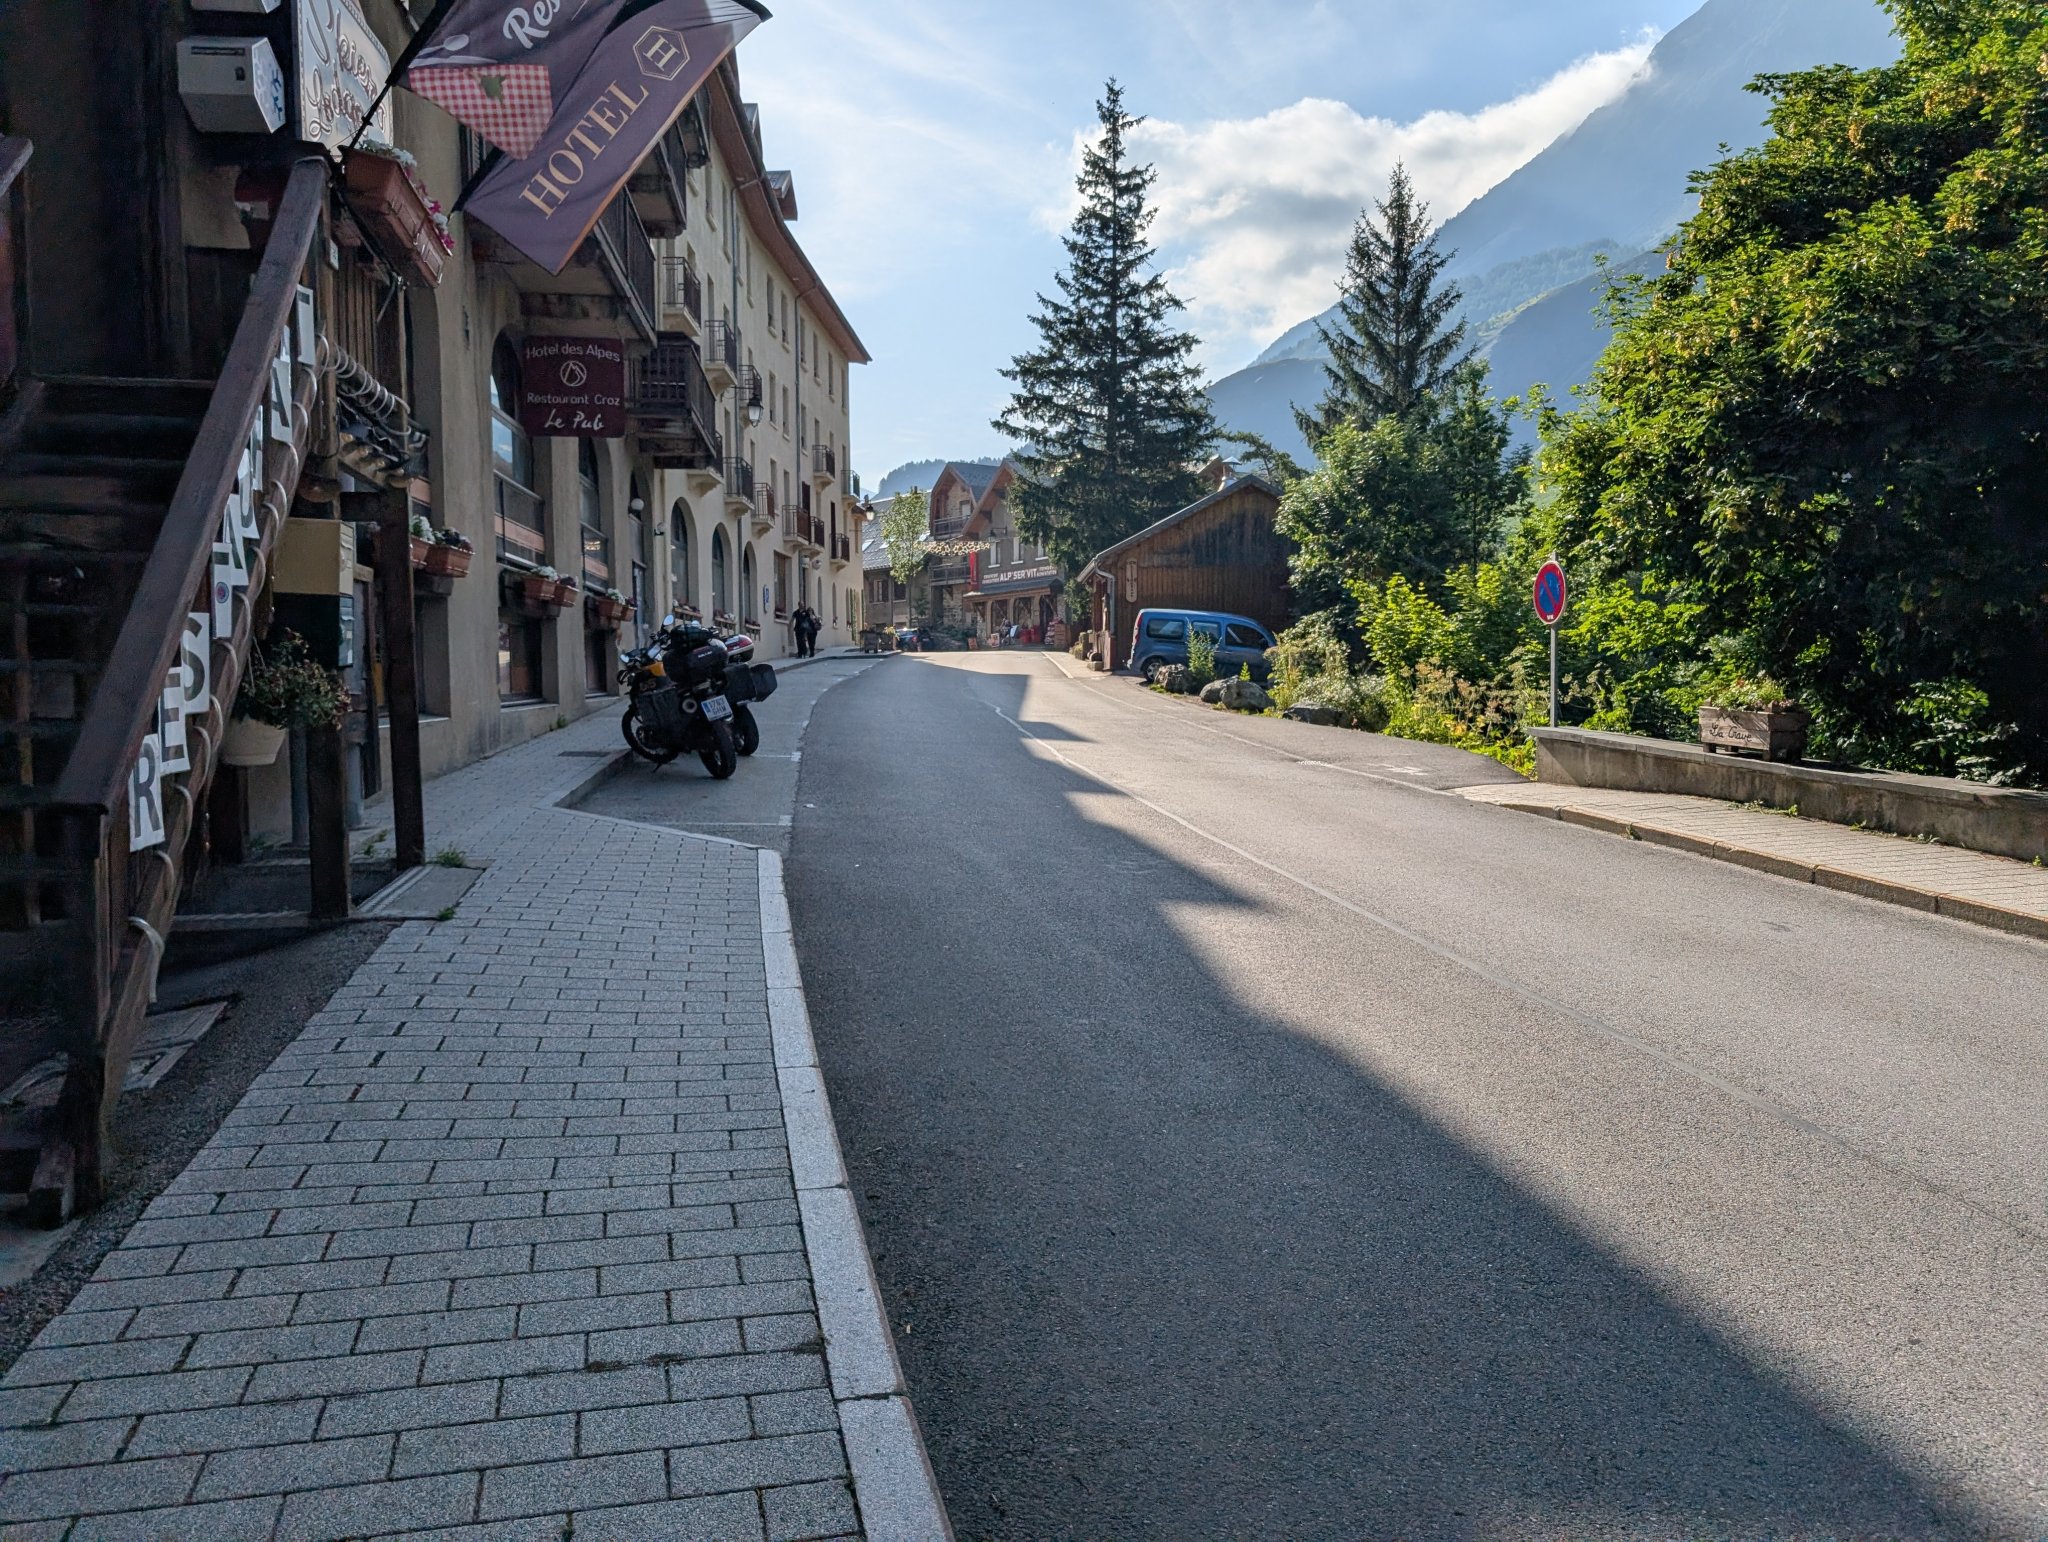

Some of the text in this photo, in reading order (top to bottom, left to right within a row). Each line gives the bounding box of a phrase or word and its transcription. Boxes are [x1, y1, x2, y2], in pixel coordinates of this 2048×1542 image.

[518, 80, 650, 220] HOTEL
[526, 343, 621, 362] Hotel des Alpes
[527, 392, 621, 406] Restaurant Croz
[544, 408, 605, 431] Le Pub
